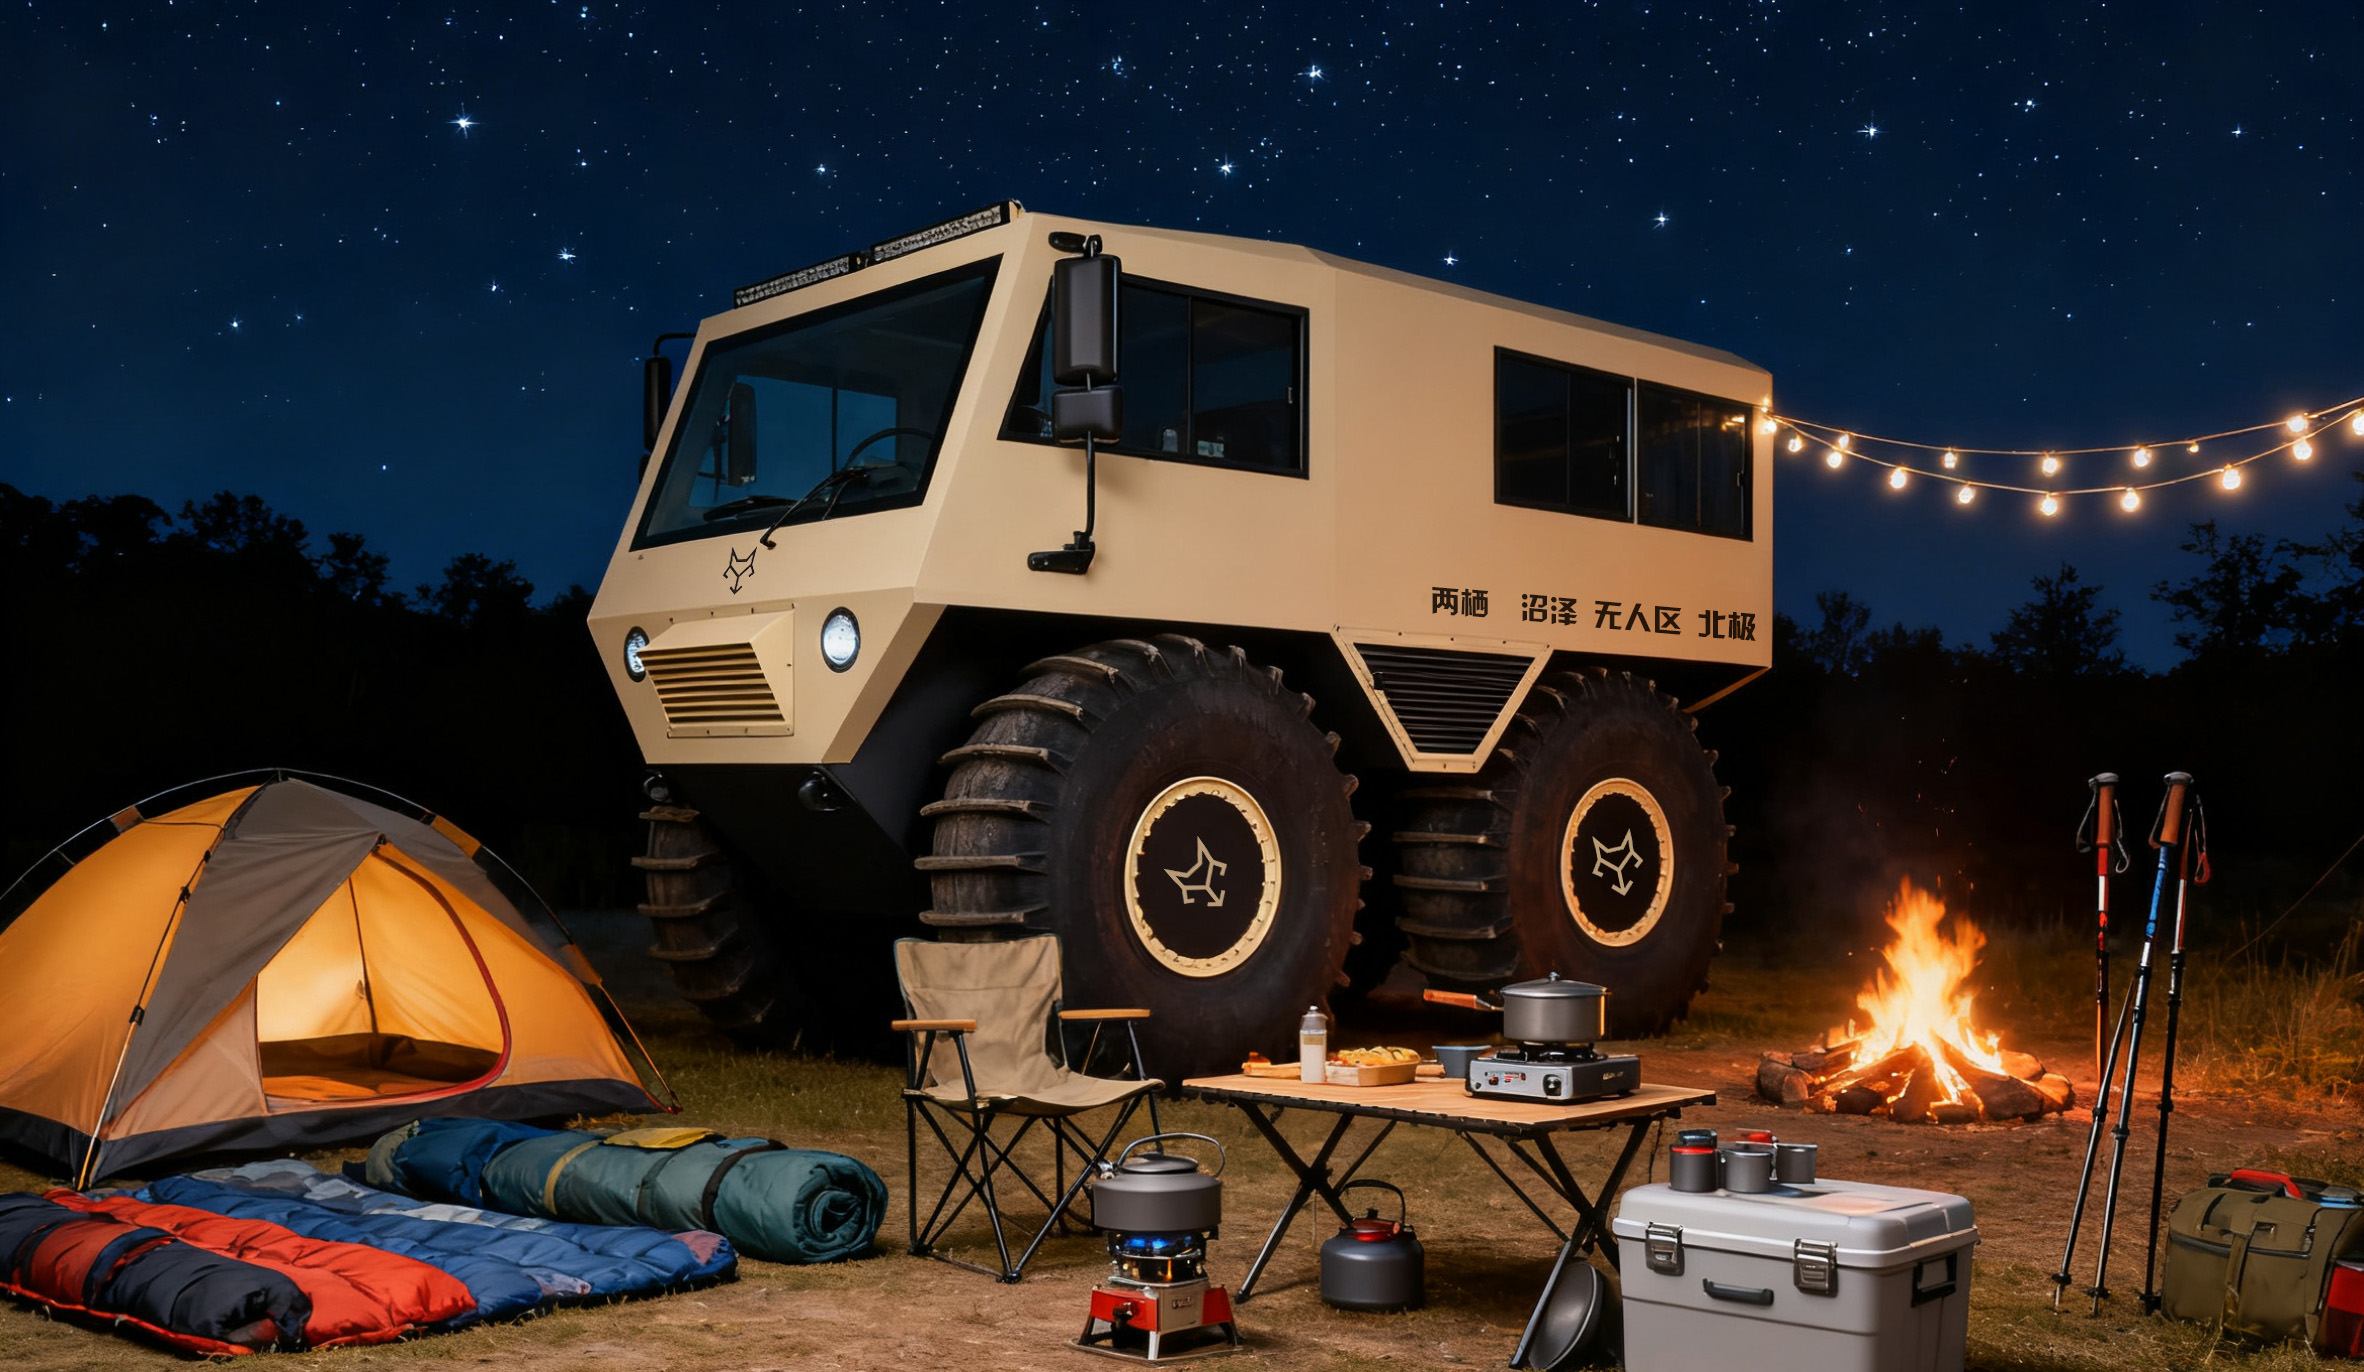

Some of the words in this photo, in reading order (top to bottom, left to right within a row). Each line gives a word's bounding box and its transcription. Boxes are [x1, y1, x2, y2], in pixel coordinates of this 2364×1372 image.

[1432, 587, 1489, 617] 两栖
[1522, 594, 1577, 625] 沼泽
[1595, 601, 1682, 635] 无人区
[1698, 610, 1756, 641] 北极
